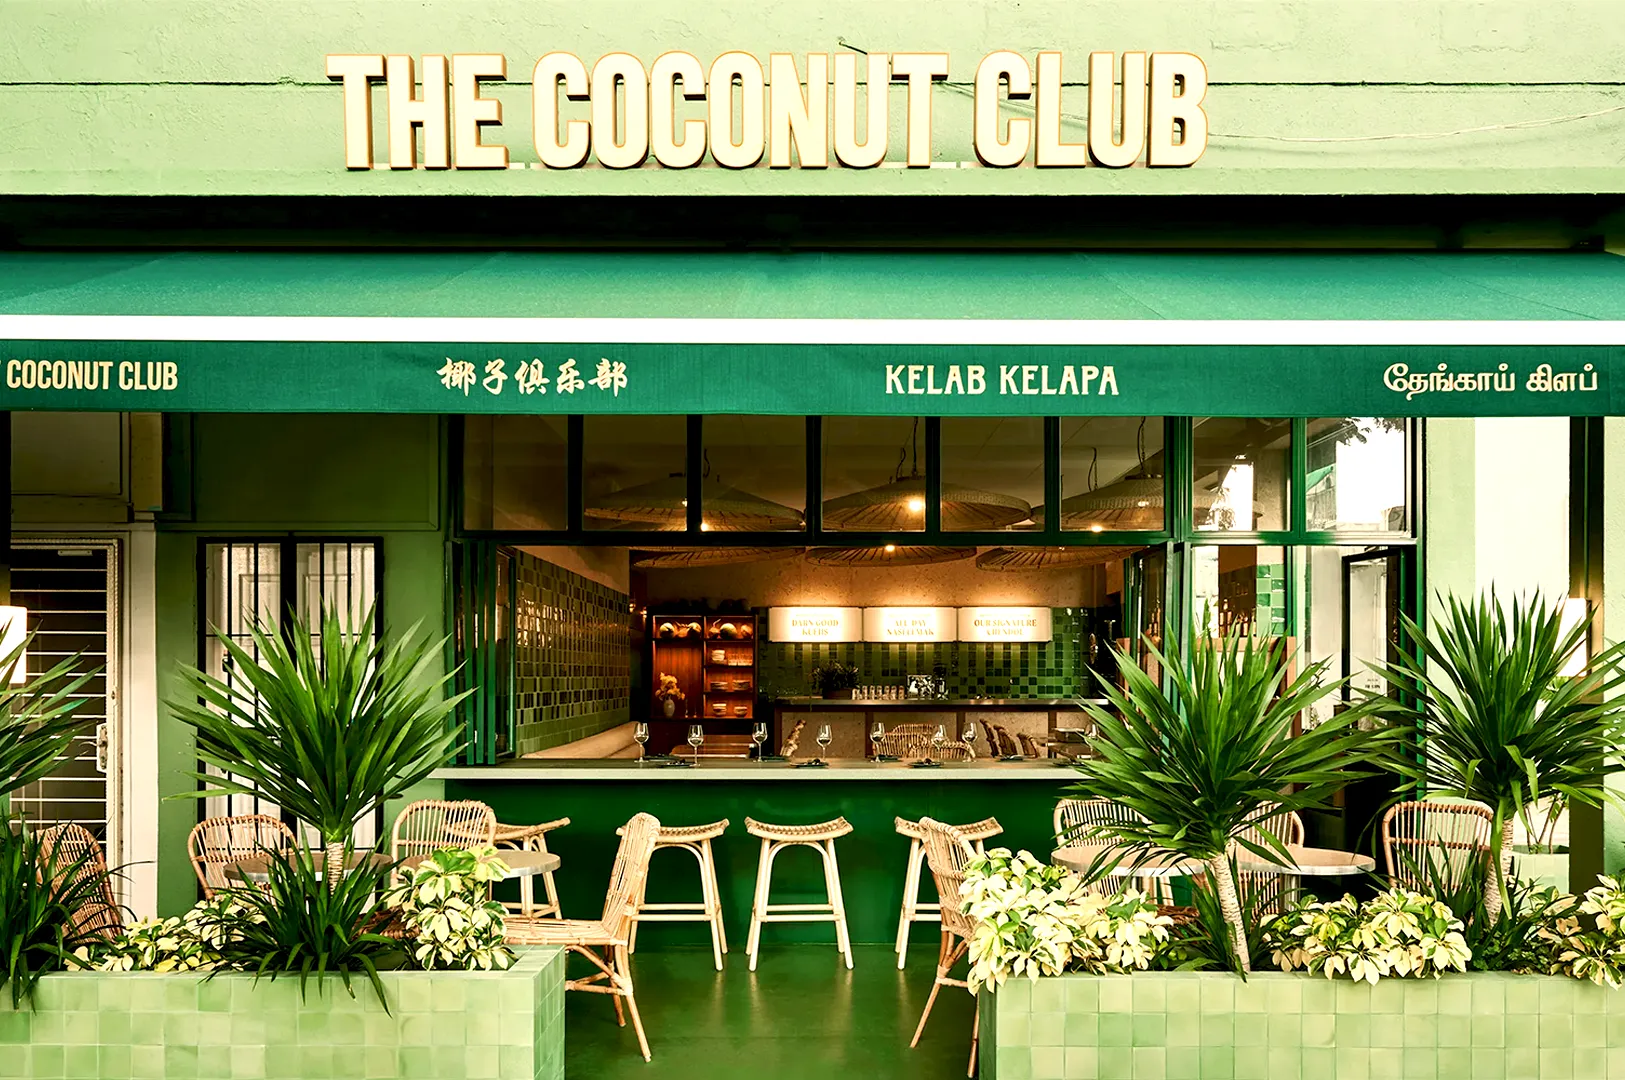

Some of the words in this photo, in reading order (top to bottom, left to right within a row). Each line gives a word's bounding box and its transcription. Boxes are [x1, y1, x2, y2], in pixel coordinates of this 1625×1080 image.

[326, 53, 509, 170] THE
[532, 51, 948, 169] COCONUT
[974, 50, 1208, 168] CLUB
[6, 359, 114, 390] COCONUT
[118, 361, 178, 391] CLUB
[436, 357, 628, 397] 椰子俱乐部
[885, 364, 987, 395] KELAB
[999, 365, 1120, 396] KELAPA
[1383, 362, 1516, 401] தேங்காய்
[1525, 363, 1598, 392] கிளப்
[815, 619, 839, 627] GOOD
[895, 619, 907, 627] ALL
[911, 619, 926, 627] DAY
[974, 619, 991, 627] OUR
[992, 619, 1037, 627] SIGNATURE
